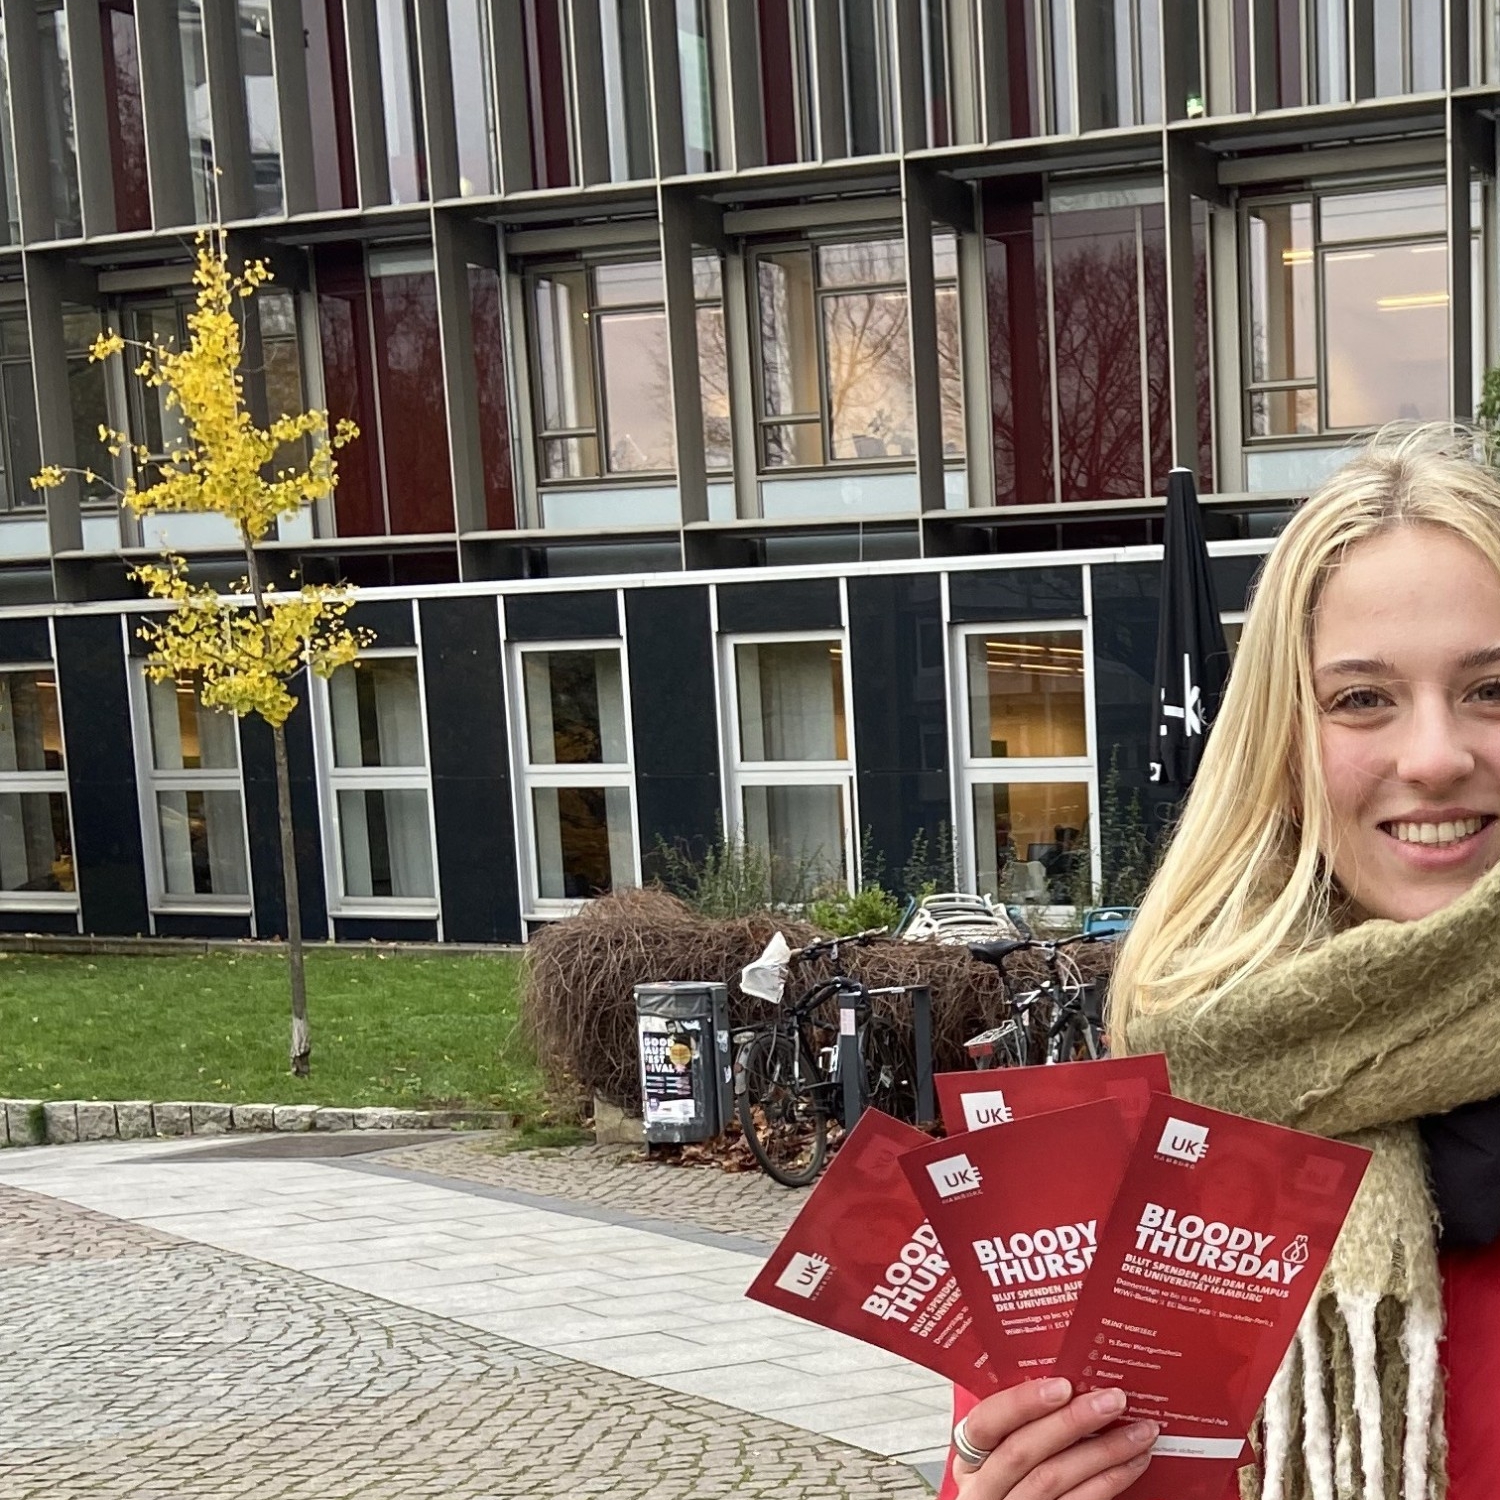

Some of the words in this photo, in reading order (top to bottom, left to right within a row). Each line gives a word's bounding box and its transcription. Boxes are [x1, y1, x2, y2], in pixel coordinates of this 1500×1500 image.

[1171, 1136, 1209, 1159] UKE
[944, 1166, 983, 1188] UKE
[972, 1220, 1097, 1265] BLOODY
[1139, 1202, 1275, 1257] BLOODY
[797, 1252, 828, 1286] UKE
[861, 1218, 939, 1317] BLOOD
[1135, 1225, 1304, 1285] THURSDAY
[992, 1291, 1016, 1303] BLUT
[1017, 1284, 1061, 1300] SPENDEN
[1063, 1280, 1083, 1292] AUF
[1121, 1263, 1142, 1277] DER
[1144, 1269, 1209, 1292] UNIVERSITÄT
[1210, 1286, 1263, 1303] HAMBURG
[1125, 1253, 1152, 1271] BLUT
[1152, 1260, 1200, 1281] SPENDEN
[1201, 1274, 1222, 1286] AUF
[1222, 1278, 1246, 1290] DEM
[1247, 1283, 1289, 1298] CAMPUS
[995, 1301, 1015, 1313] DER
[1016, 1291, 1078, 1309] UNIVERSITÄT
[909, 1311, 930, 1333] BLUT
[919, 1320, 938, 1338] DER
